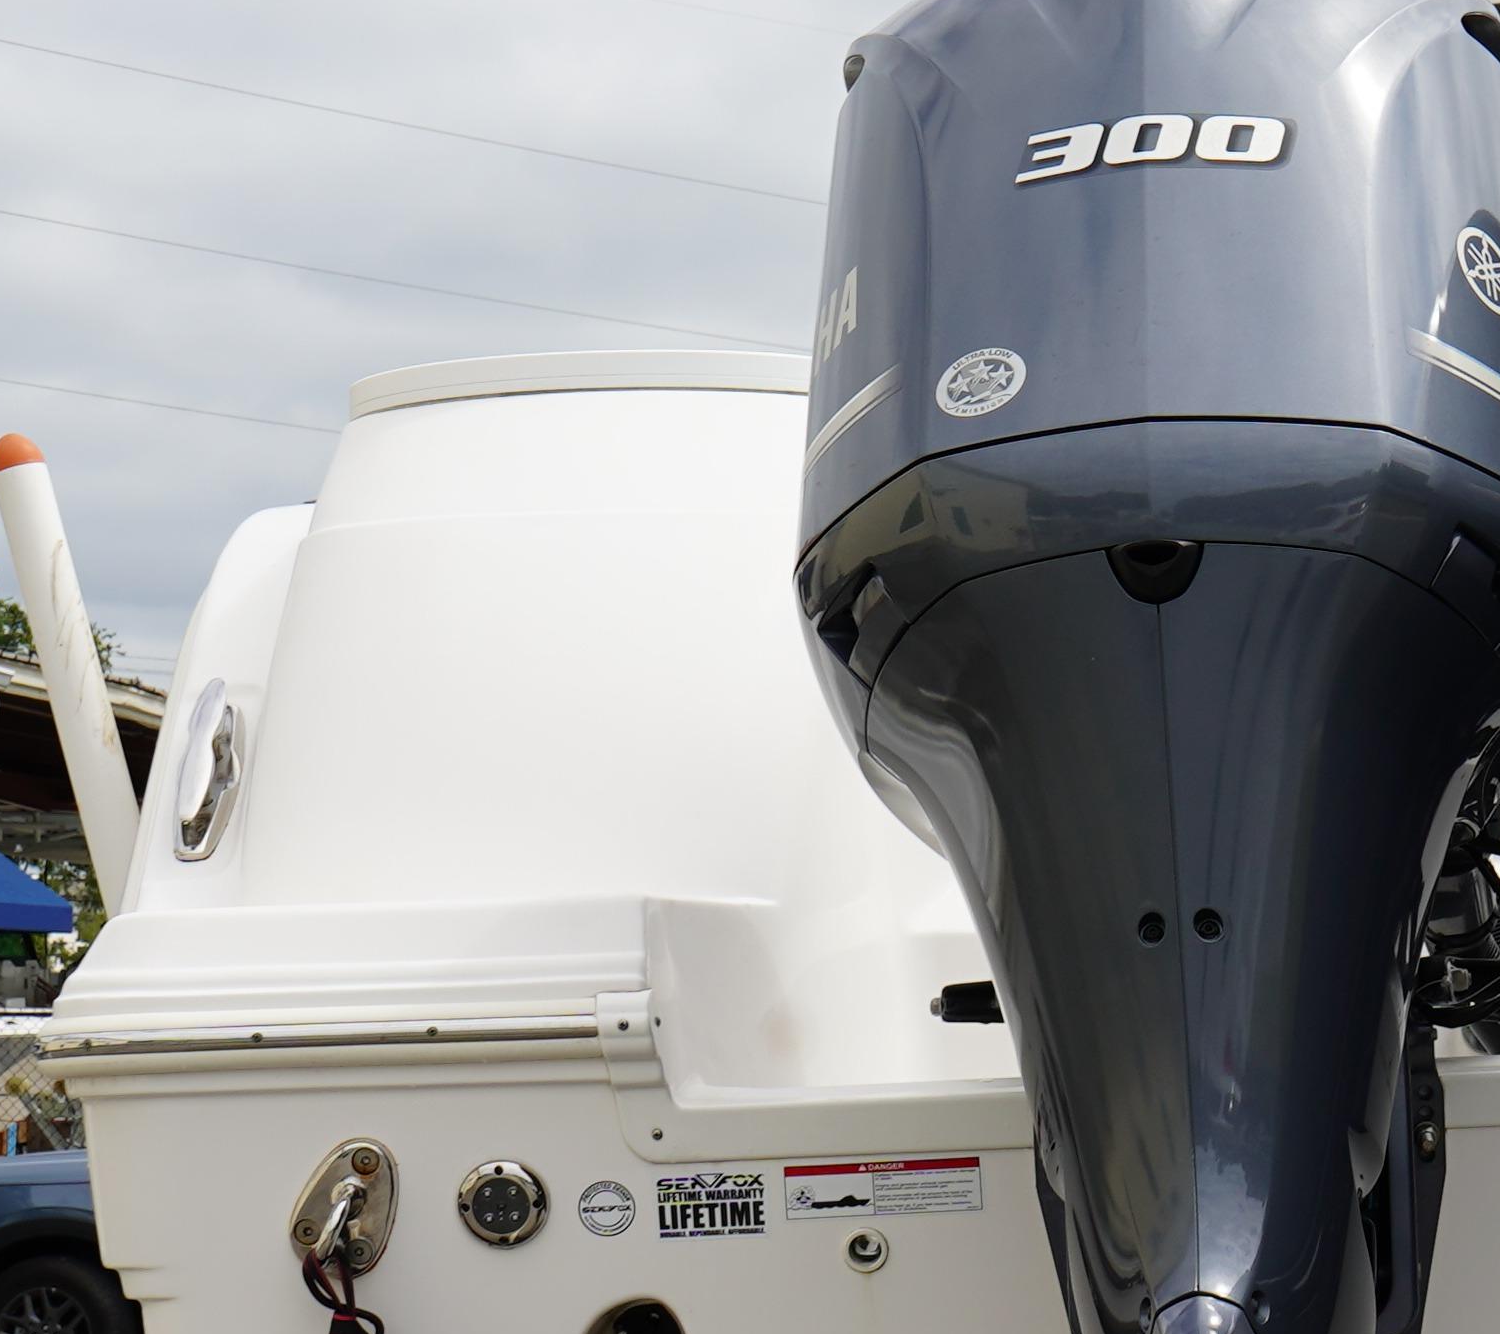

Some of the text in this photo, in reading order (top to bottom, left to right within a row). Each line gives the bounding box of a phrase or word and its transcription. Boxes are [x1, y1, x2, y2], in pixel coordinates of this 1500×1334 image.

[1015, 115, 1286, 184] 300
[867, 1162, 905, 1171] DANGER
[658, 1188, 765, 1203] LIFETIME WARRANTY
[658, 1200, 766, 1230] LIFETIME
